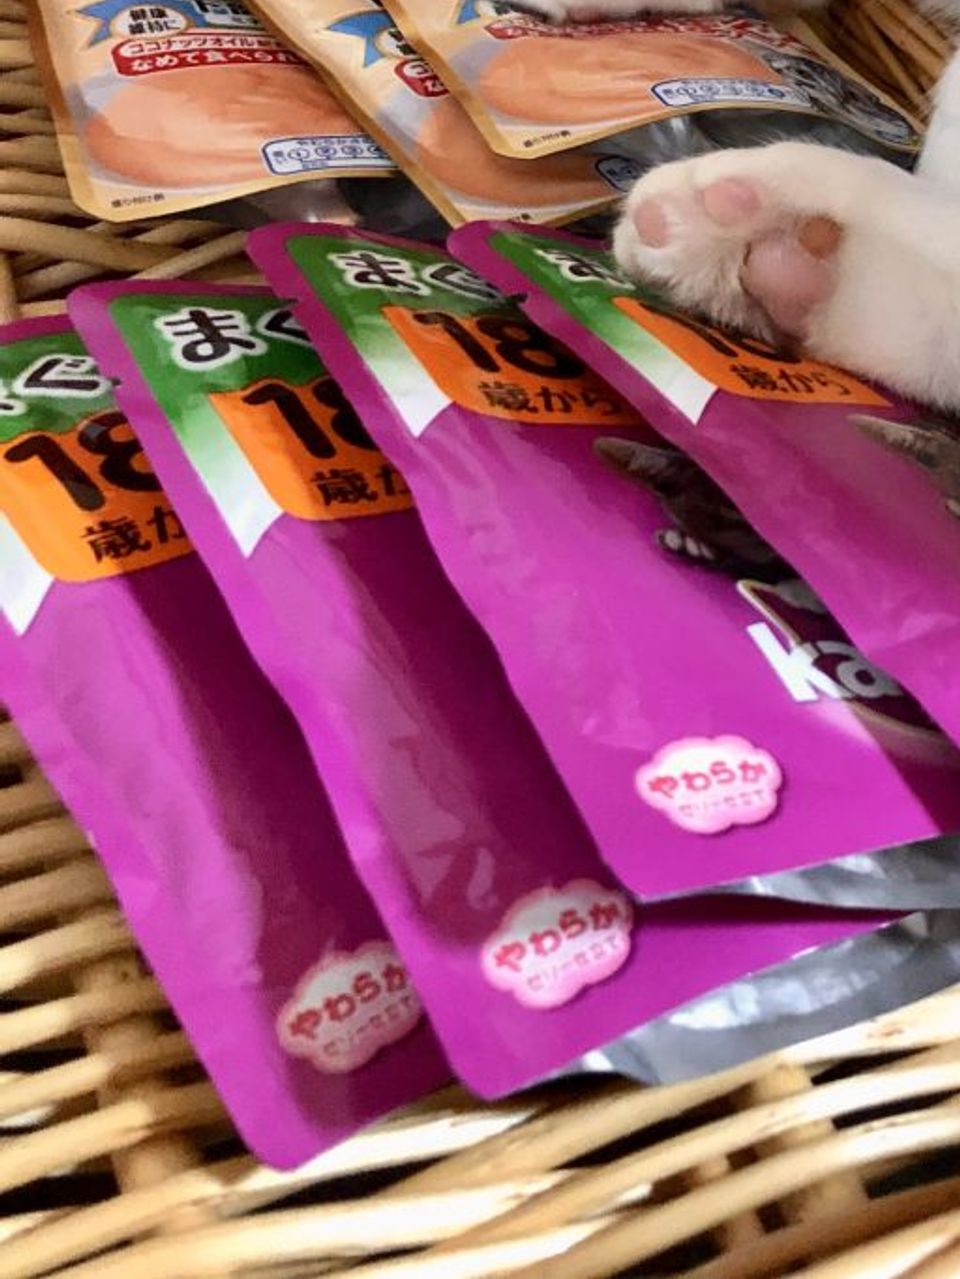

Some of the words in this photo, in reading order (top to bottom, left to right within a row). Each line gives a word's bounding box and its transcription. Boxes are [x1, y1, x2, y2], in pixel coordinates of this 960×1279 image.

[412, 308, 590, 381] 18
[478, 380, 624, 416] 歳から
[646, 759, 768, 800] やわらか
[492, 900, 621, 973] やわらか
